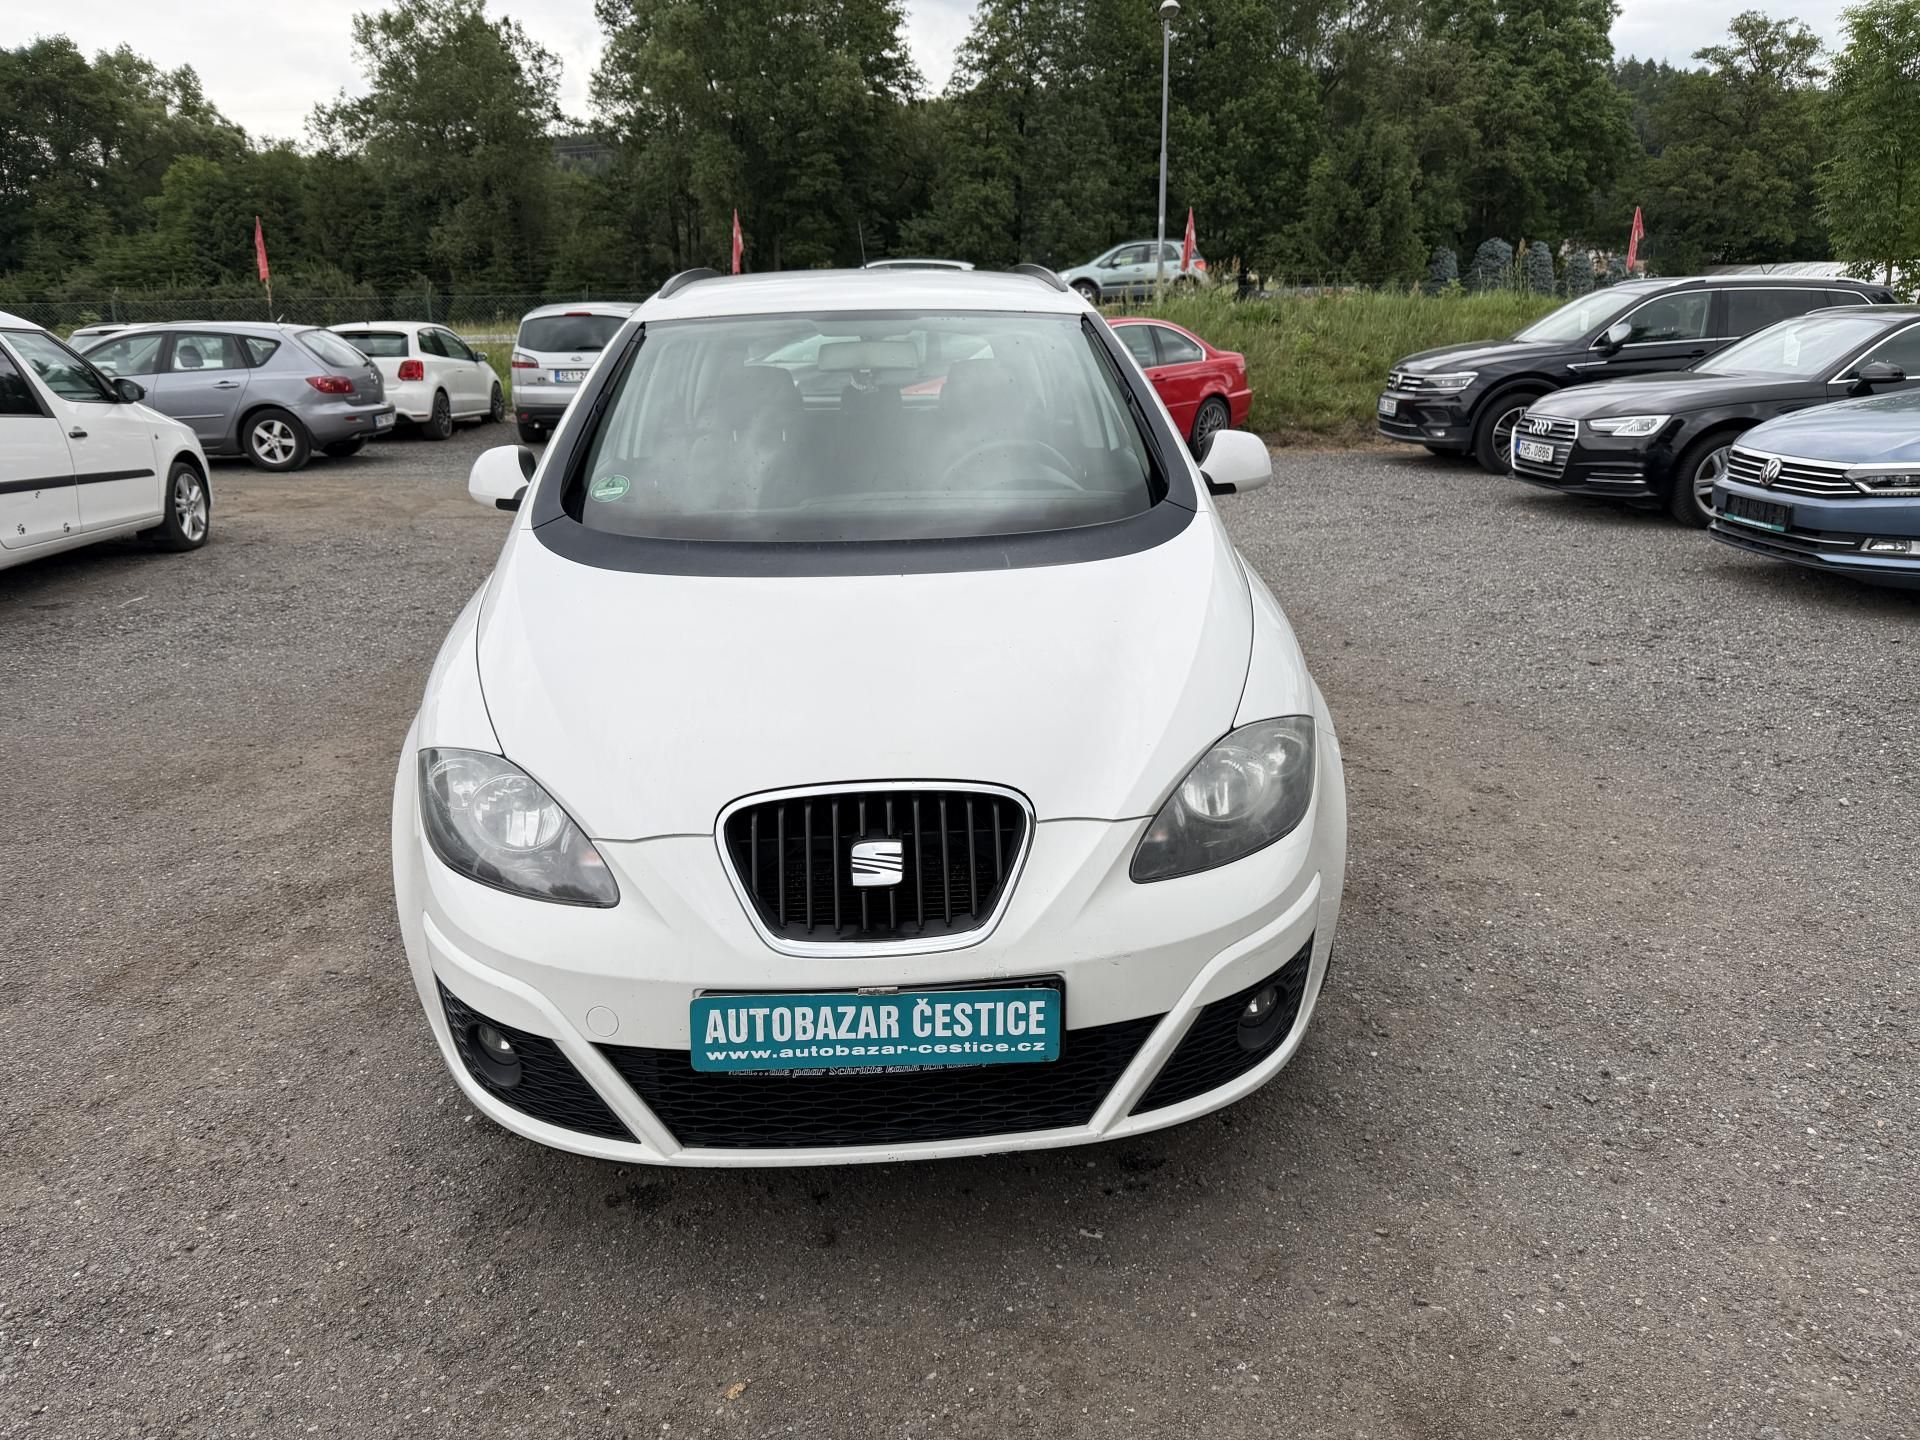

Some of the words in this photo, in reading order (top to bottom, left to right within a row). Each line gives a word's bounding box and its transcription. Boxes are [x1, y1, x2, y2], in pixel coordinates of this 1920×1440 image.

[705, 1005, 900, 1044] AUTOBAZAR
[912, 998, 1046, 1038] ČESTICE
[706, 1042, 1046, 1061] www.autobazar-cestice.cz
